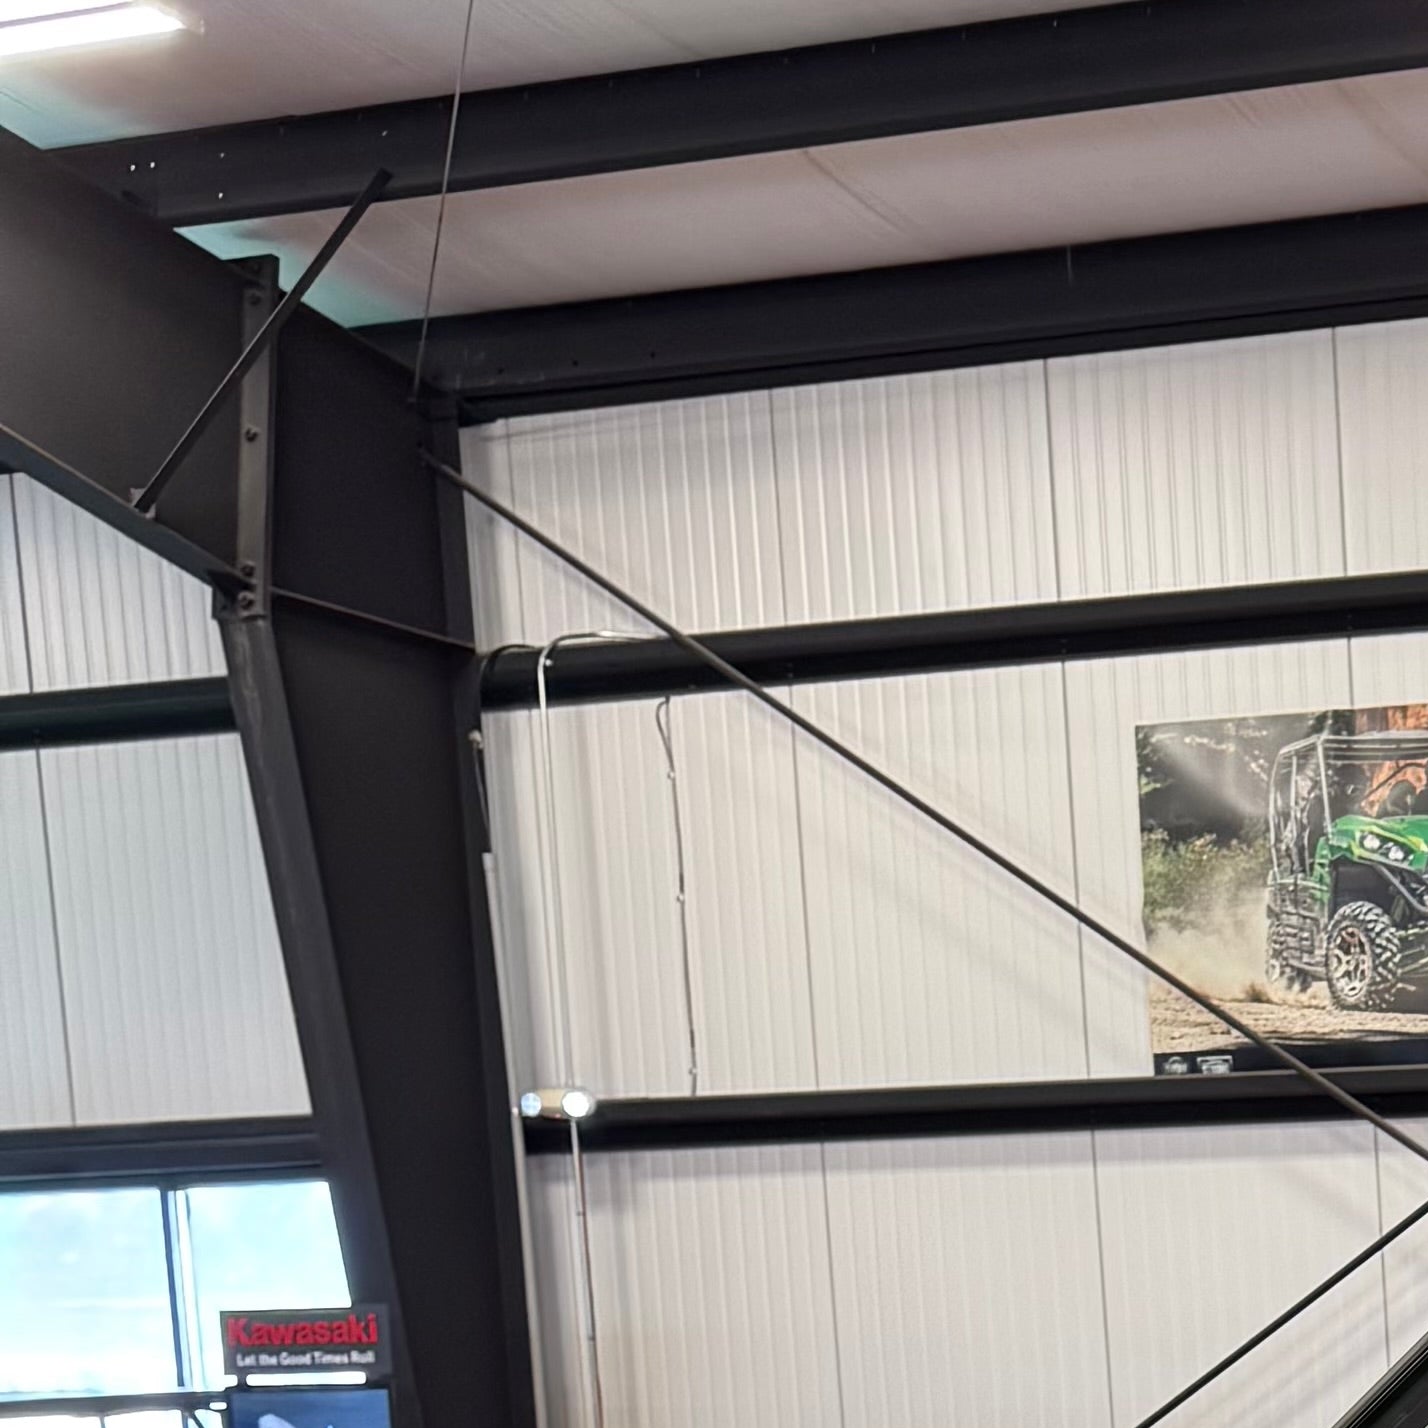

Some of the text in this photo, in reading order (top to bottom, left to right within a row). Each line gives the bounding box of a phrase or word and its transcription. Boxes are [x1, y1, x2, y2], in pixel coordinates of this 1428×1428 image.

[226, 1312, 378, 1347] Kawasaki
[236, 1350, 376, 1367] Let the Good Times Roll
